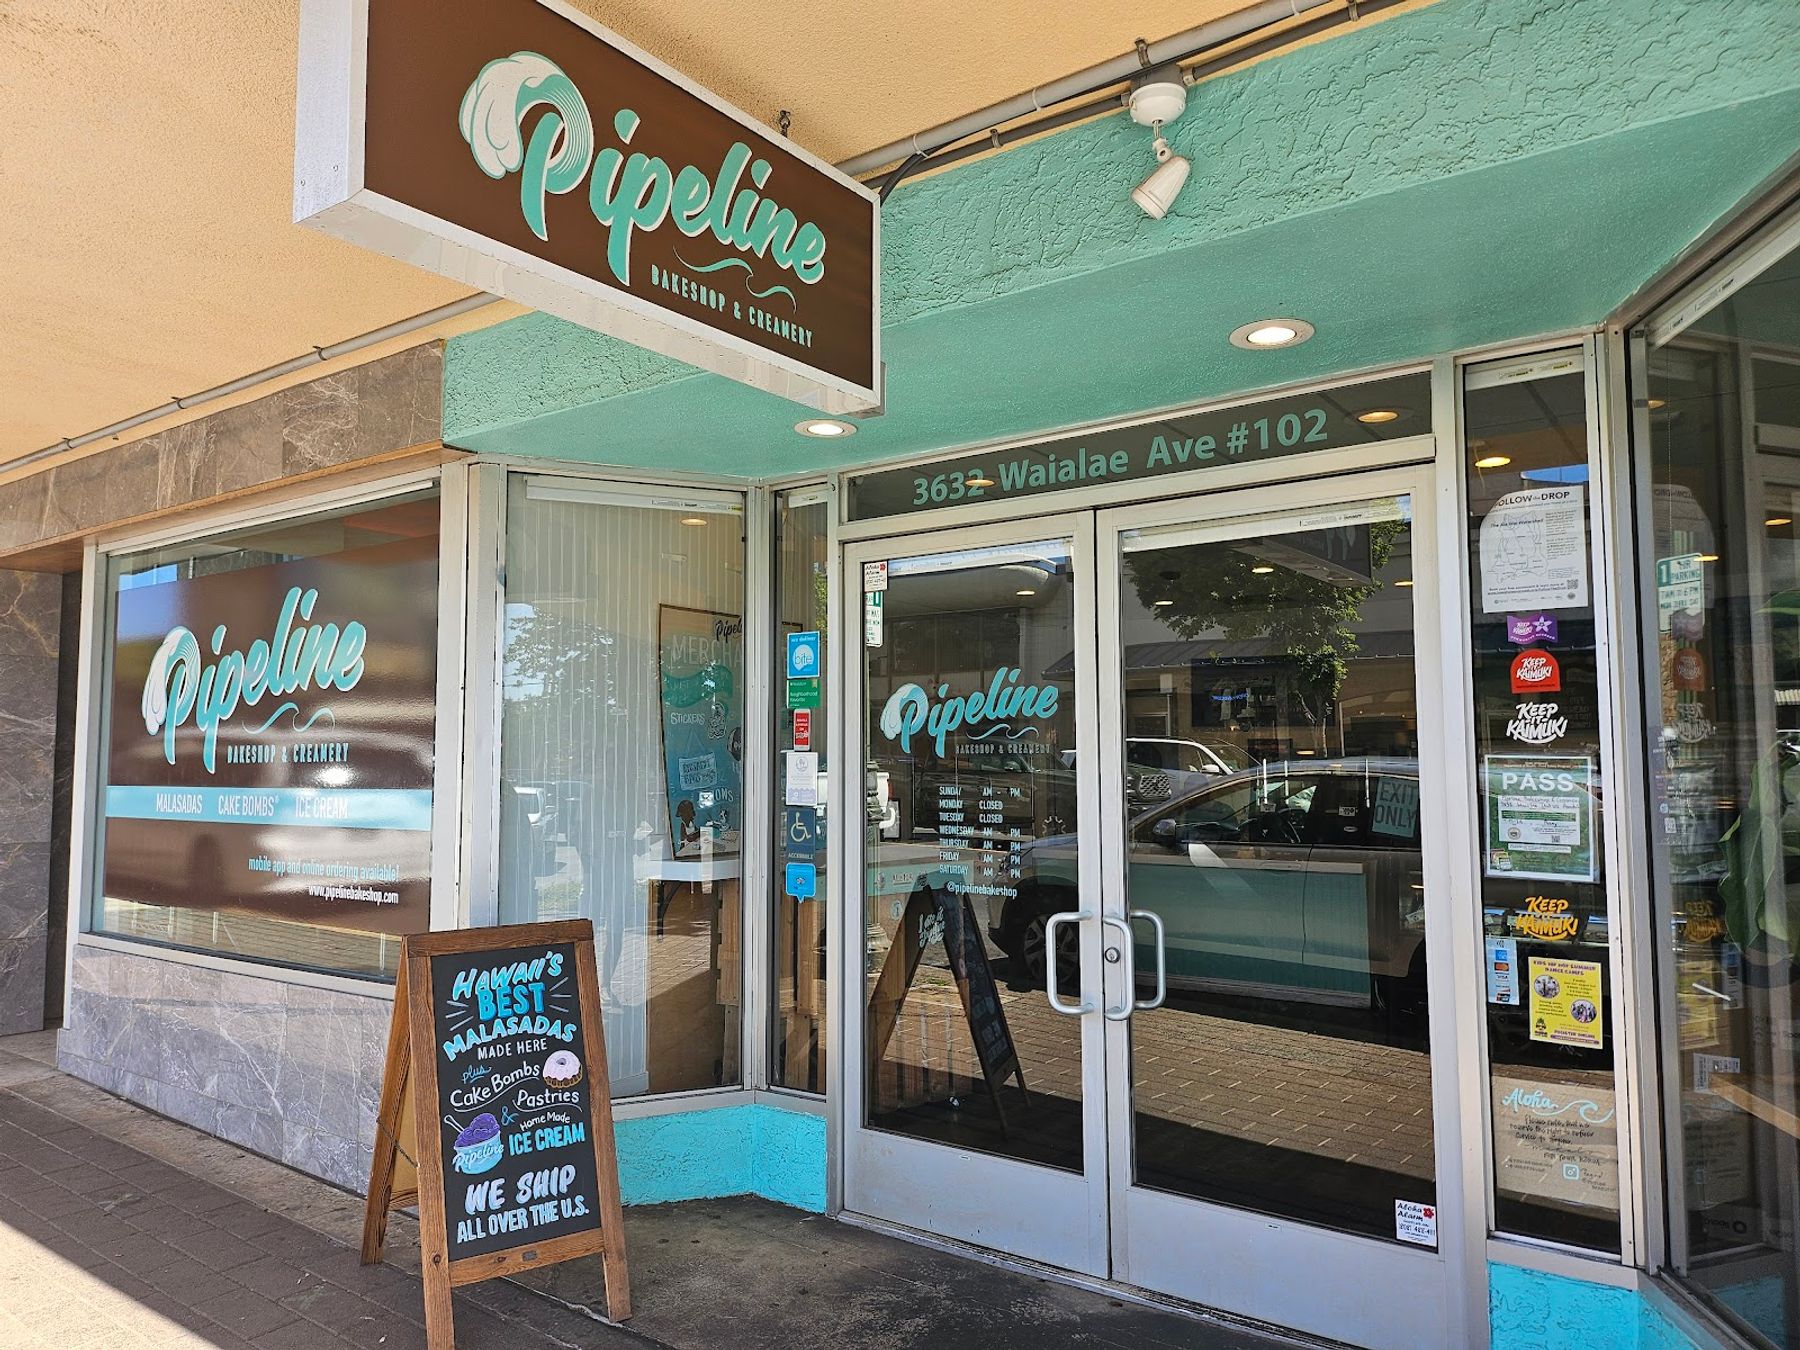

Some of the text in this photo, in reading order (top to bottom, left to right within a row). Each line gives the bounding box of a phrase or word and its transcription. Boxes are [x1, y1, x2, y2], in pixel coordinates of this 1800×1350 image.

[459, 51, 826, 286] Pipeline
[651, 264, 813, 348] BAKESHOP & CREAMERY
[913, 409, 1328, 505] 3632 Waialae Ave #102
[1541, 491, 1570, 501] DROP
[1516, 665, 1553, 680] KAIMUKI
[1521, 657, 1547, 669] KEEP
[142, 586, 367, 775] Pipeline
[880, 667, 1059, 758] Pipeline
[1515, 701, 1559, 720] KEEP
[1506, 716, 1568, 740] KAIMUKI
[227, 743, 349, 764] BAKESHOP & CREAMERY
[955, 743, 1051, 754] BAKESHOP & CREAMERY
[939, 786, 962, 796] SUNDAY
[982, 787, 993, 797] AM
[1010, 788, 1021, 797] PM
[1502, 772, 1574, 791] PASS
[1380, 782, 1418, 805] EXIT
[156, 793, 203, 815] MALASADAS
[218, 795, 241, 816] CAKE
[295, 797, 313, 817] ICE
[313, 798, 349, 819] CREAM
[939, 799, 1004, 810] MONDAY CLOSED
[939, 812, 1004, 824] TUESDAY CLOSED
[1375, 804, 1417, 829] ONLY
[939, 825, 1021, 838] WEDNESDAY AM PM
[939, 838, 969, 849] THURSDAY
[983, 840, 993, 850] AM
[1010, 842, 1021, 852] PM
[940, 851, 960, 861] FRIDAY
[983, 854, 993, 863] AM
[1010, 855, 1021, 865] PM
[248, 855, 400, 883] mobile app and online ordering available!
[940, 864, 969, 876] SATURDAY
[983, 867, 993, 877] AM
[1010, 869, 1021, 879] PM
[308, 883, 399, 906] www.pipelinebakeshop.com
[947, 881, 1018, 900] @pipelinebakeshop
[1525, 895, 1569, 913] KEEP
[452, 951, 563, 1001] HAWAII'S
[477, 982, 545, 1021] BEST
[443, 1015, 577, 1061] MALASADAS
[477, 1038, 547, 1060] MADE HERE
[450, 1061, 540, 1107] Cake Bombs
[462, 1065, 492, 1084] plus
[517, 1088, 580, 1107] Pastries
[1502, 1088, 1559, 1113] Aloha
[501, 1105, 519, 1126] &
[520, 1111, 571, 1131] Home Made
[509, 1122, 586, 1156] ICE CREAM
[452, 1141, 505, 1172] Pipeline
[465, 1164, 576, 1215] WE SHIP
[1397, 1202, 1422, 1213] Aloha
[1397, 1210, 1423, 1221] Alarm
[457, 1195, 590, 1244] ALL OVER THE U.S.
